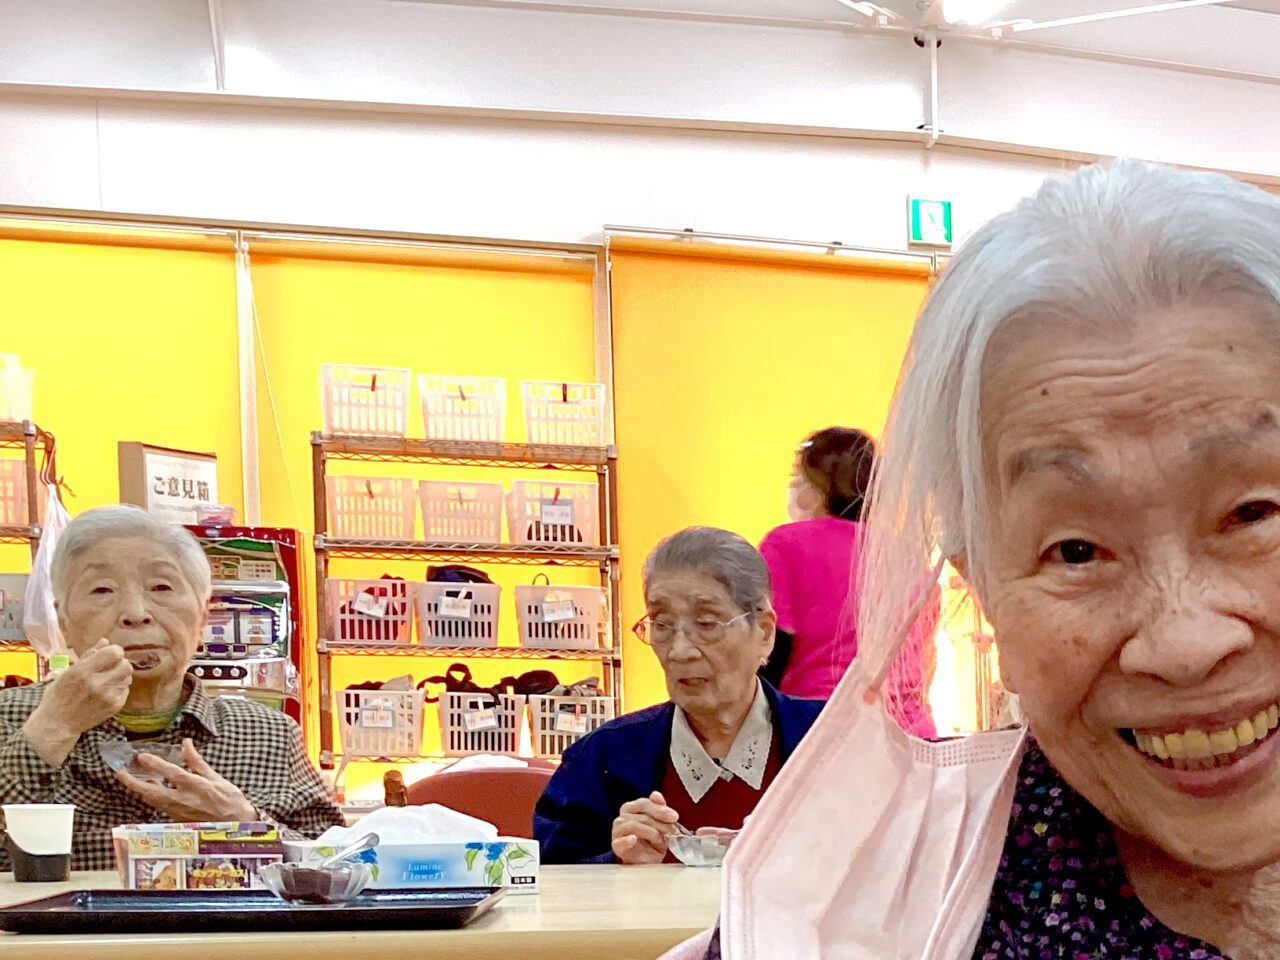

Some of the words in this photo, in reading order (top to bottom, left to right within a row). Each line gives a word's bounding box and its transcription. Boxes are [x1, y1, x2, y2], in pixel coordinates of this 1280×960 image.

[153, 476, 210, 502] ご意見箱
[407, 863, 443, 871] Lumine
